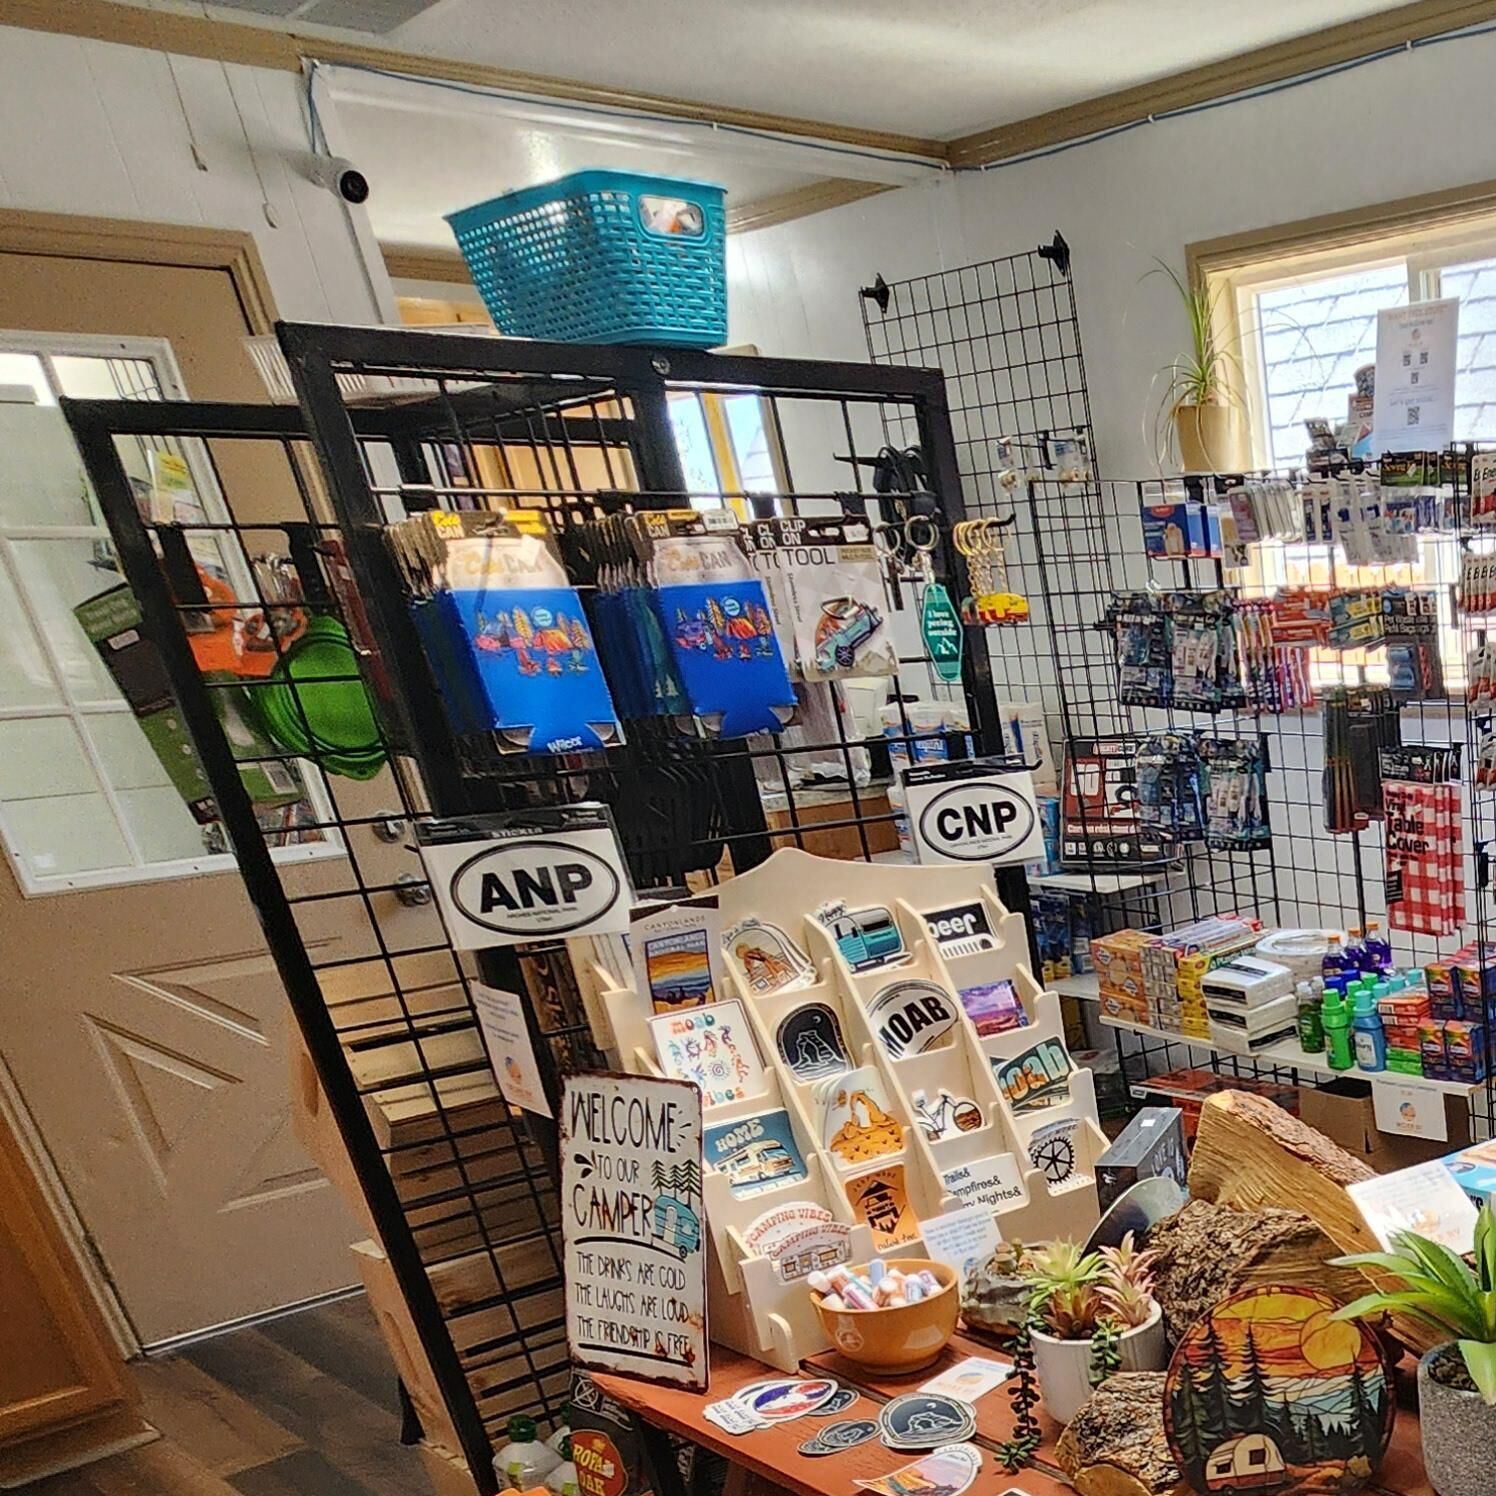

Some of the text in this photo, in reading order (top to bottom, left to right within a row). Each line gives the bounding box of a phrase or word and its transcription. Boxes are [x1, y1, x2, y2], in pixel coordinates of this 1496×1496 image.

[780, 519, 806, 534] CLIP
[781, 532, 801, 546] ON
[786, 546, 835, 567] TOOL
[936, 800, 1018, 842] CNP
[1386, 812, 1425, 836] Table
[1387, 833, 1429, 852] Cover
[480, 863, 594, 914] ANP
[671, 1012, 716, 1036] moab
[570, 1090, 681, 1153] WELCOME
[715, 1118, 765, 1152] HOME
[597, 1154, 640, 1183] TO OUR
[572, 1183, 653, 1237] CAMPER
[977, 1185, 1023, 1205] Nights&
[576, 1250, 687, 1291] THE DRINKS ARE COLD
[574, 1281, 690, 1325] THE LAUGHS ARE LOUD
[577, 1314, 595, 1341] THE
[597, 1318, 651, 1350] FRIENDSHIP
[666, 1334, 690, 1358] FREE
